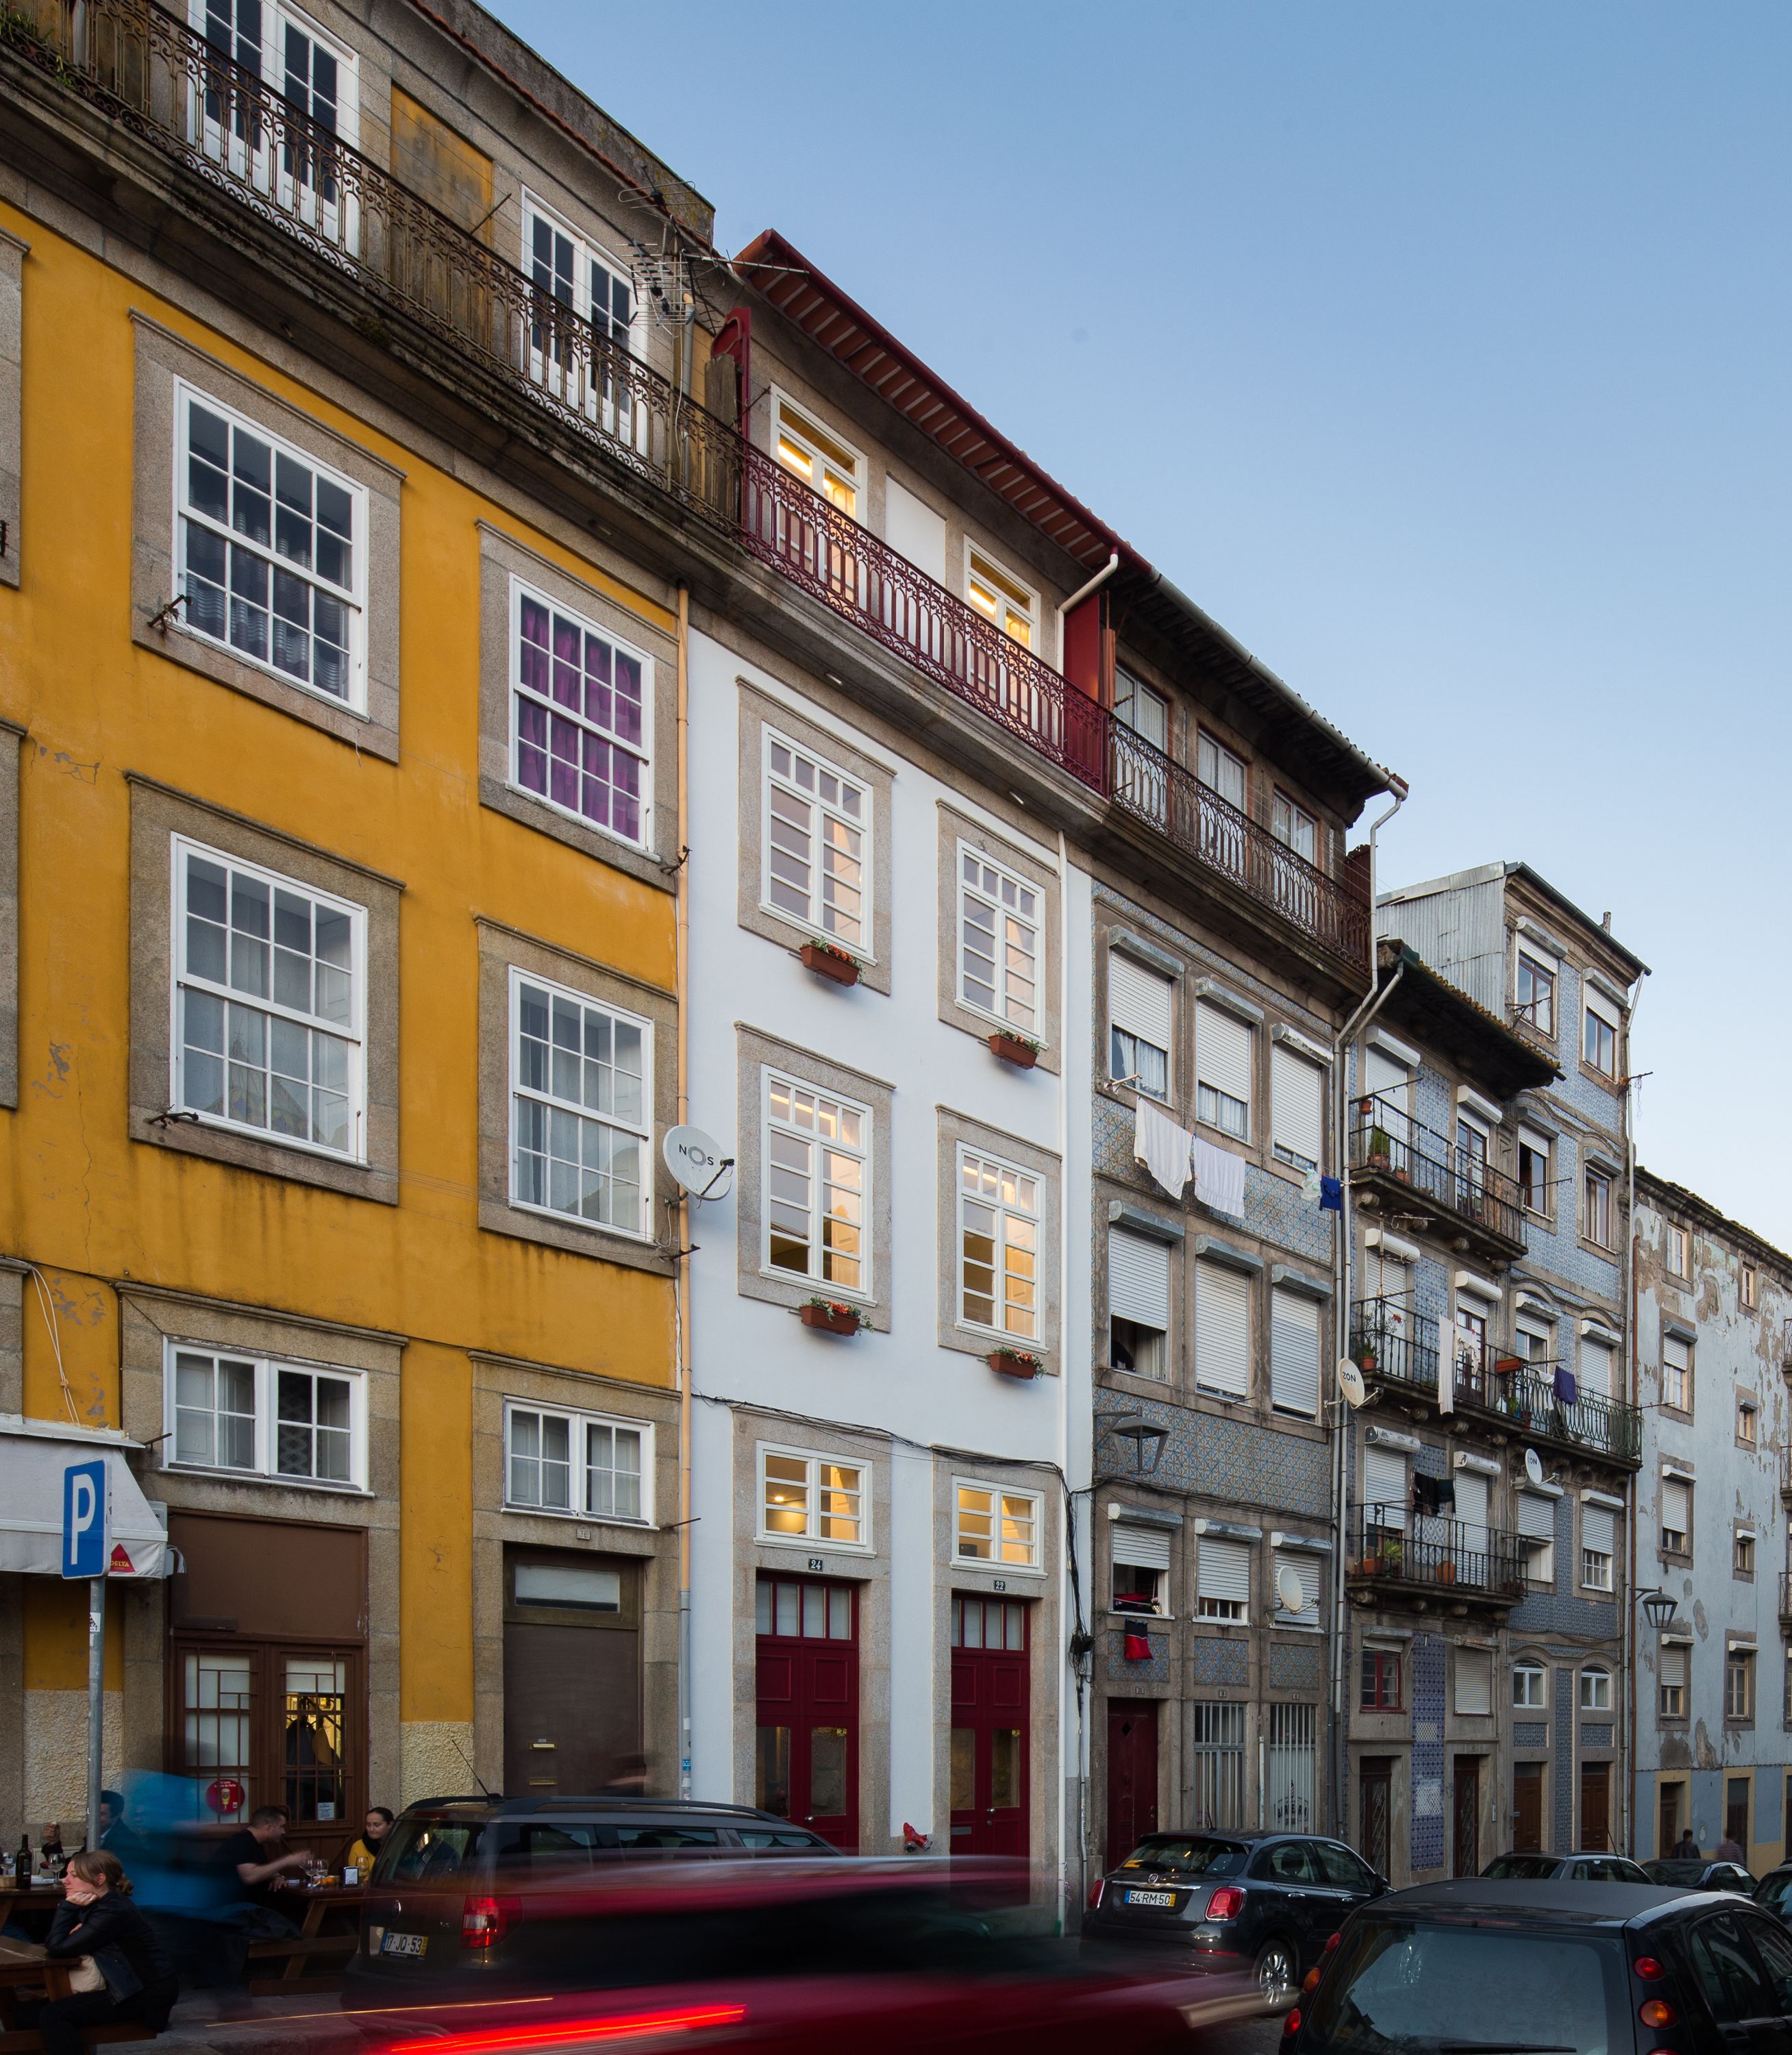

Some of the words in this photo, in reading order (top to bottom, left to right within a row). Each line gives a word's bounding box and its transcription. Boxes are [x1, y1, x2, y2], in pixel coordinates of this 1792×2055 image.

[679, 1144, 714, 1165] NOS
[1343, 1372, 1356, 1382] ZON
[71, 1473, 96, 1565] P
[810, 1560, 821, 1569] 24
[995, 1581, 1004, 1590] 22
